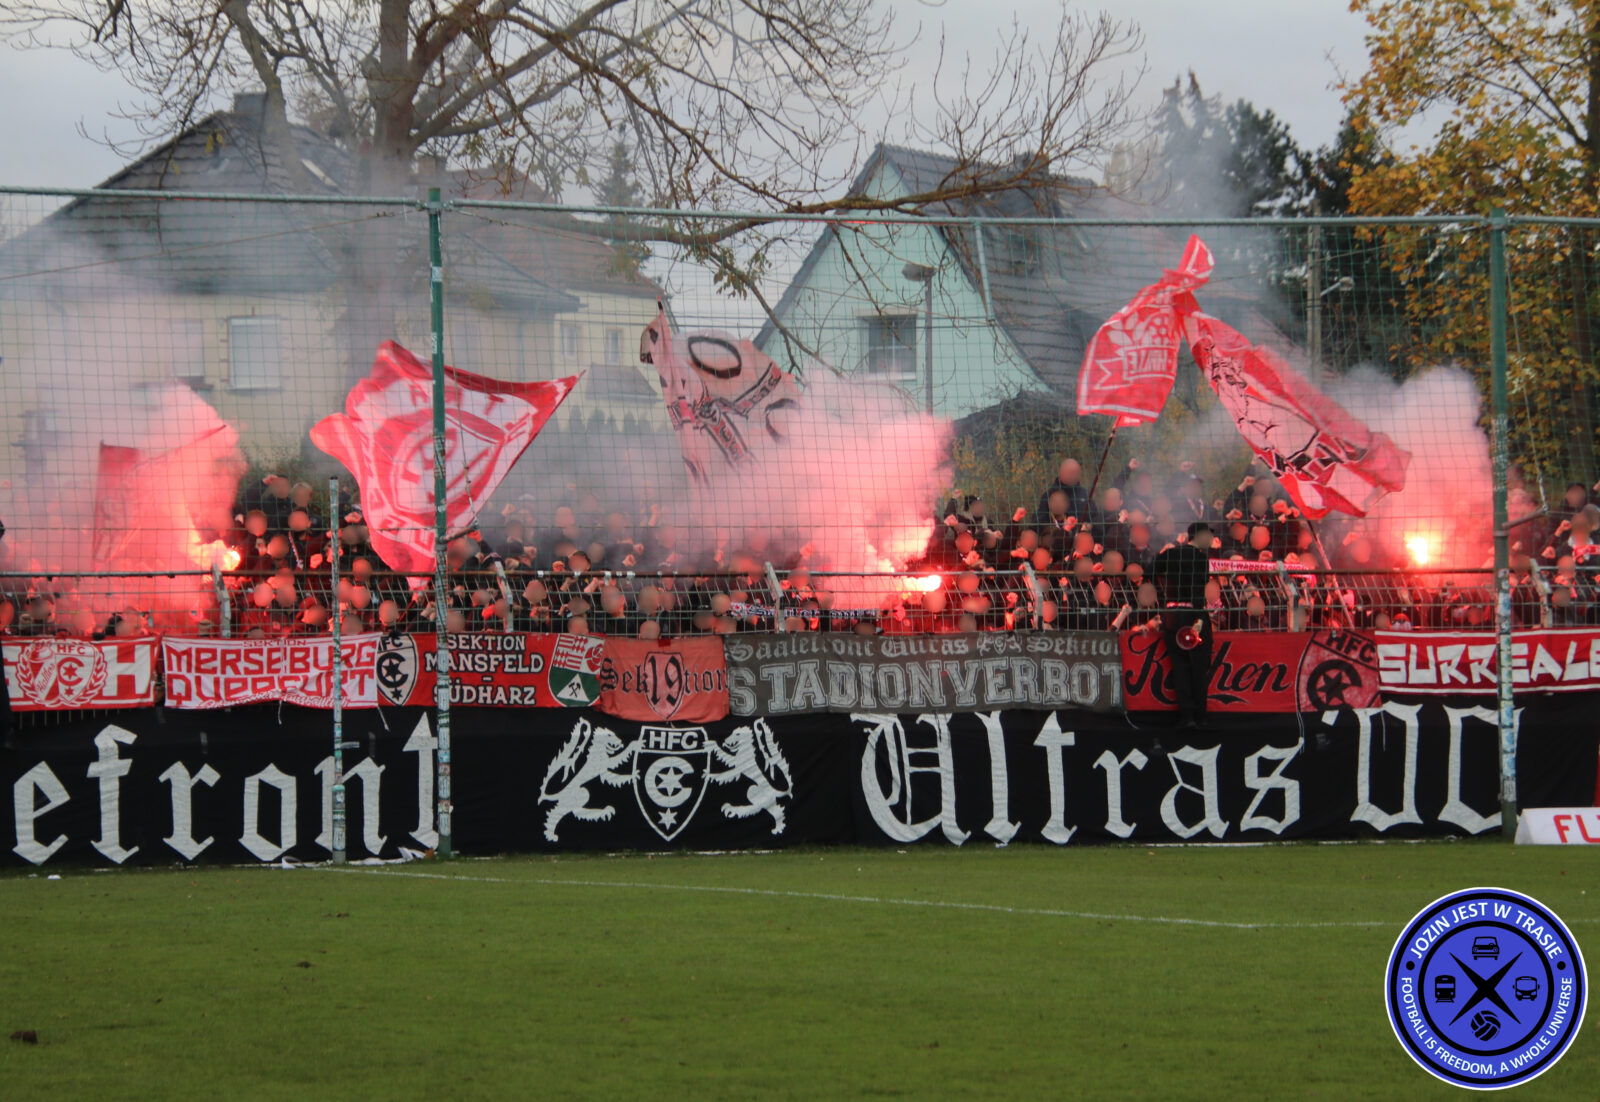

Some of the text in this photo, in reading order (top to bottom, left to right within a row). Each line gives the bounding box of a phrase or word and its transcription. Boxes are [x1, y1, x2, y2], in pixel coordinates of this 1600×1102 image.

[57, 644, 86, 655] HFC
[447, 635, 526, 650] SEKTION
[1326, 631, 1376, 663] HFC
[728, 657, 1122, 717] STADIONVERBOT
[649, 730, 698, 750] HFC
